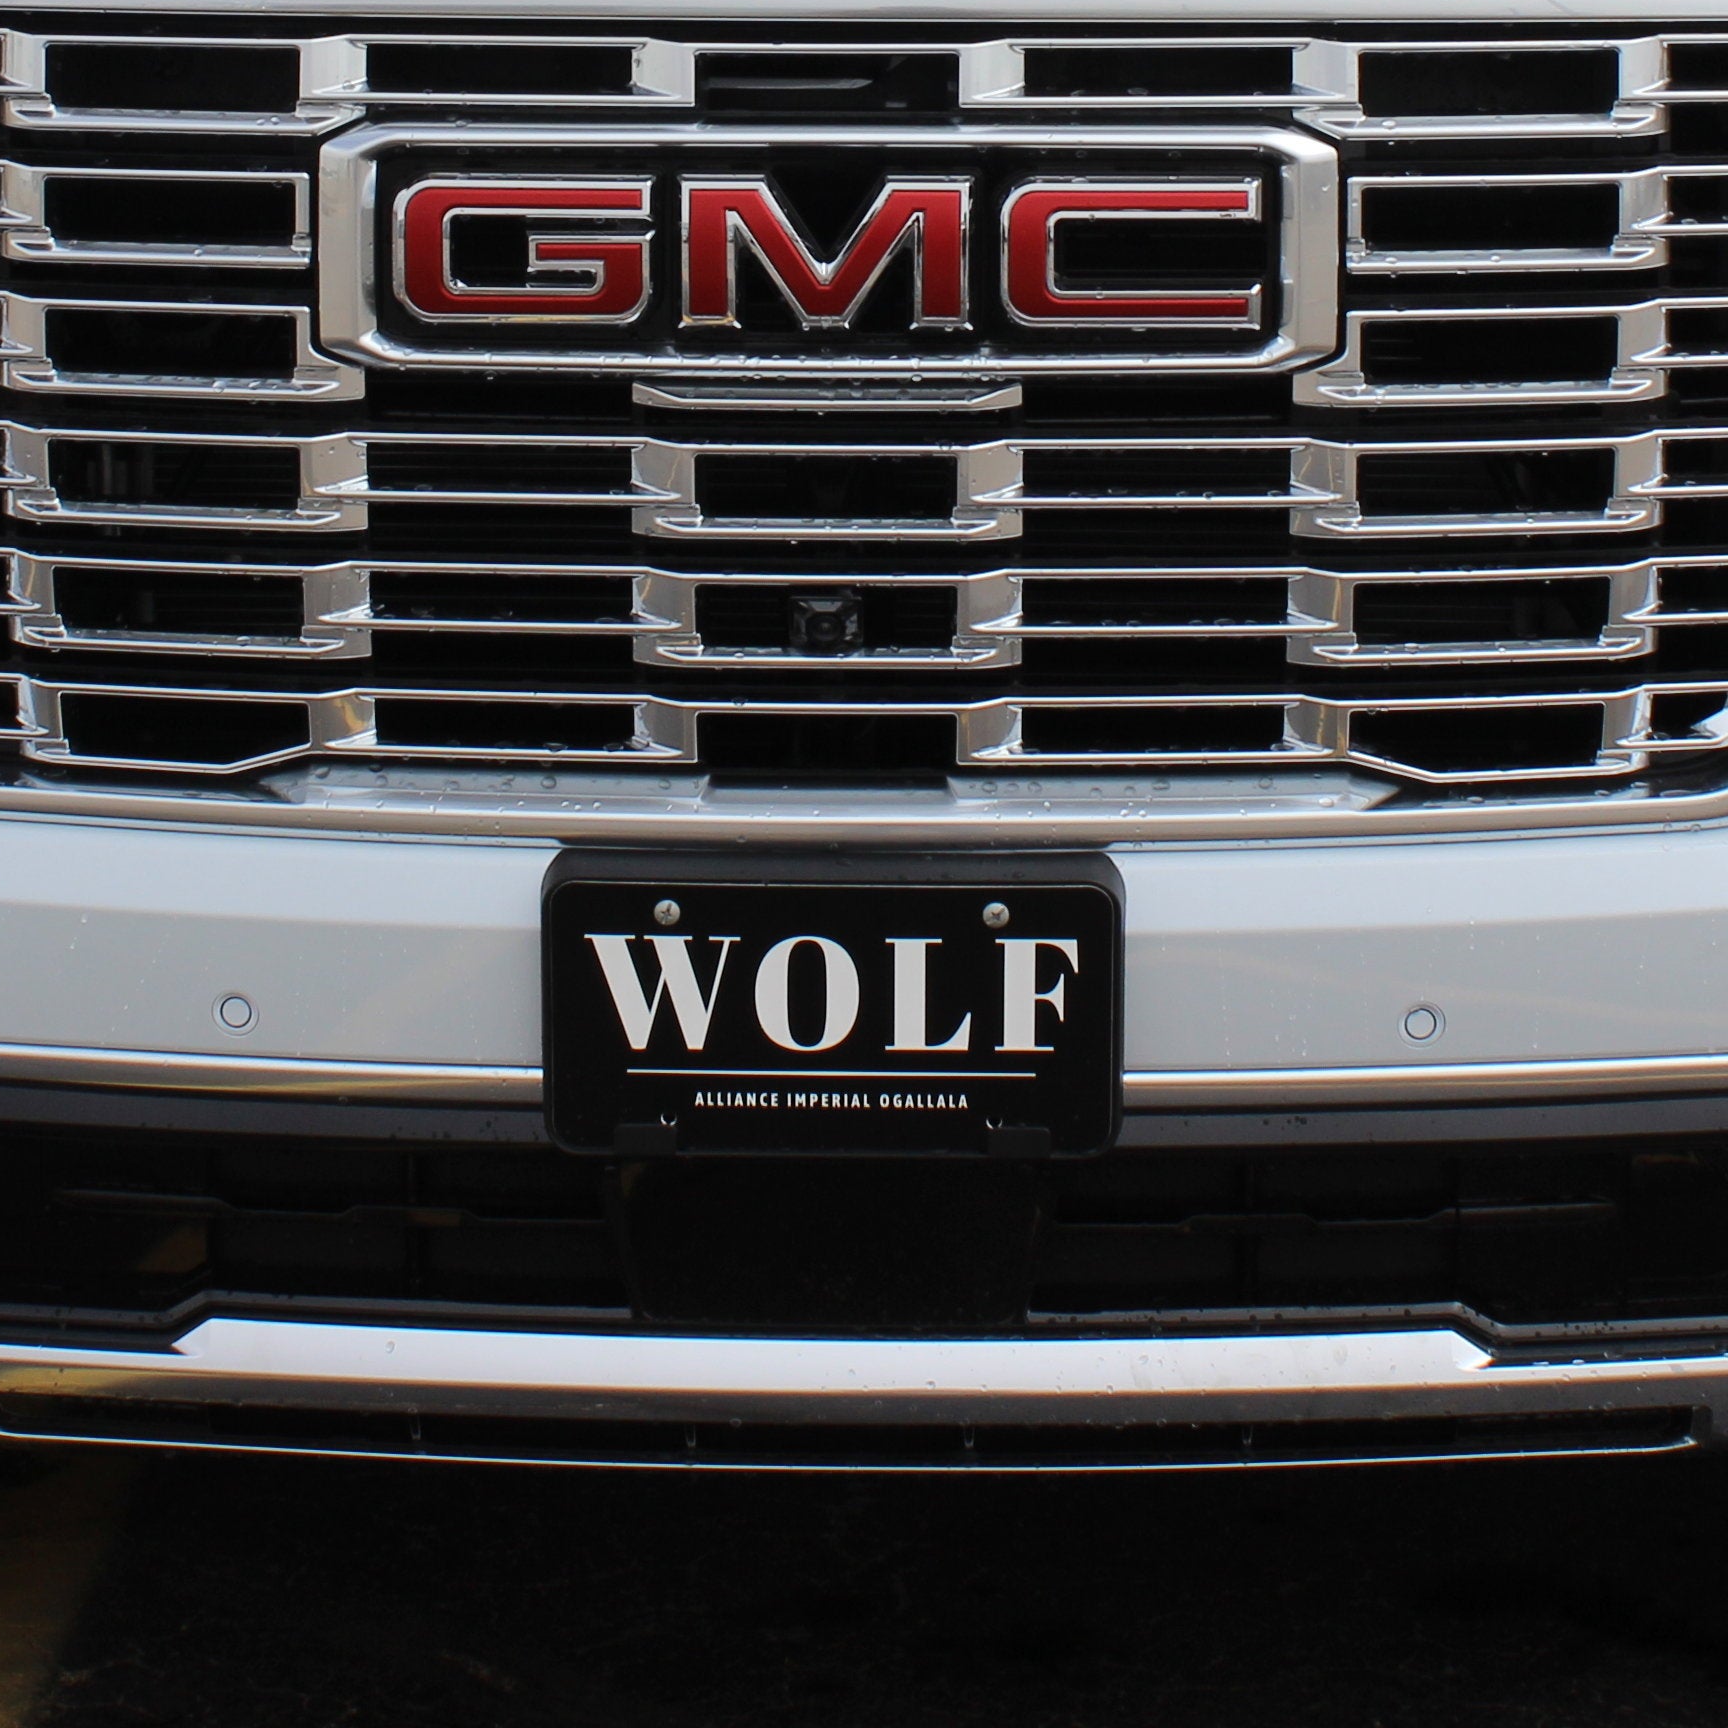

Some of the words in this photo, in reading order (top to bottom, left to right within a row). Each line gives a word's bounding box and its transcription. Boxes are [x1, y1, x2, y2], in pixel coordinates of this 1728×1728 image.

[393, 173, 1263, 330] GMC
[583, 934, 1080, 1053] WOLF
[694, 1091, 779, 1107] ALLIANCE
[787, 1092, 871, 1108] IMPERIAL
[879, 1093, 969, 1109] OGALLALA
